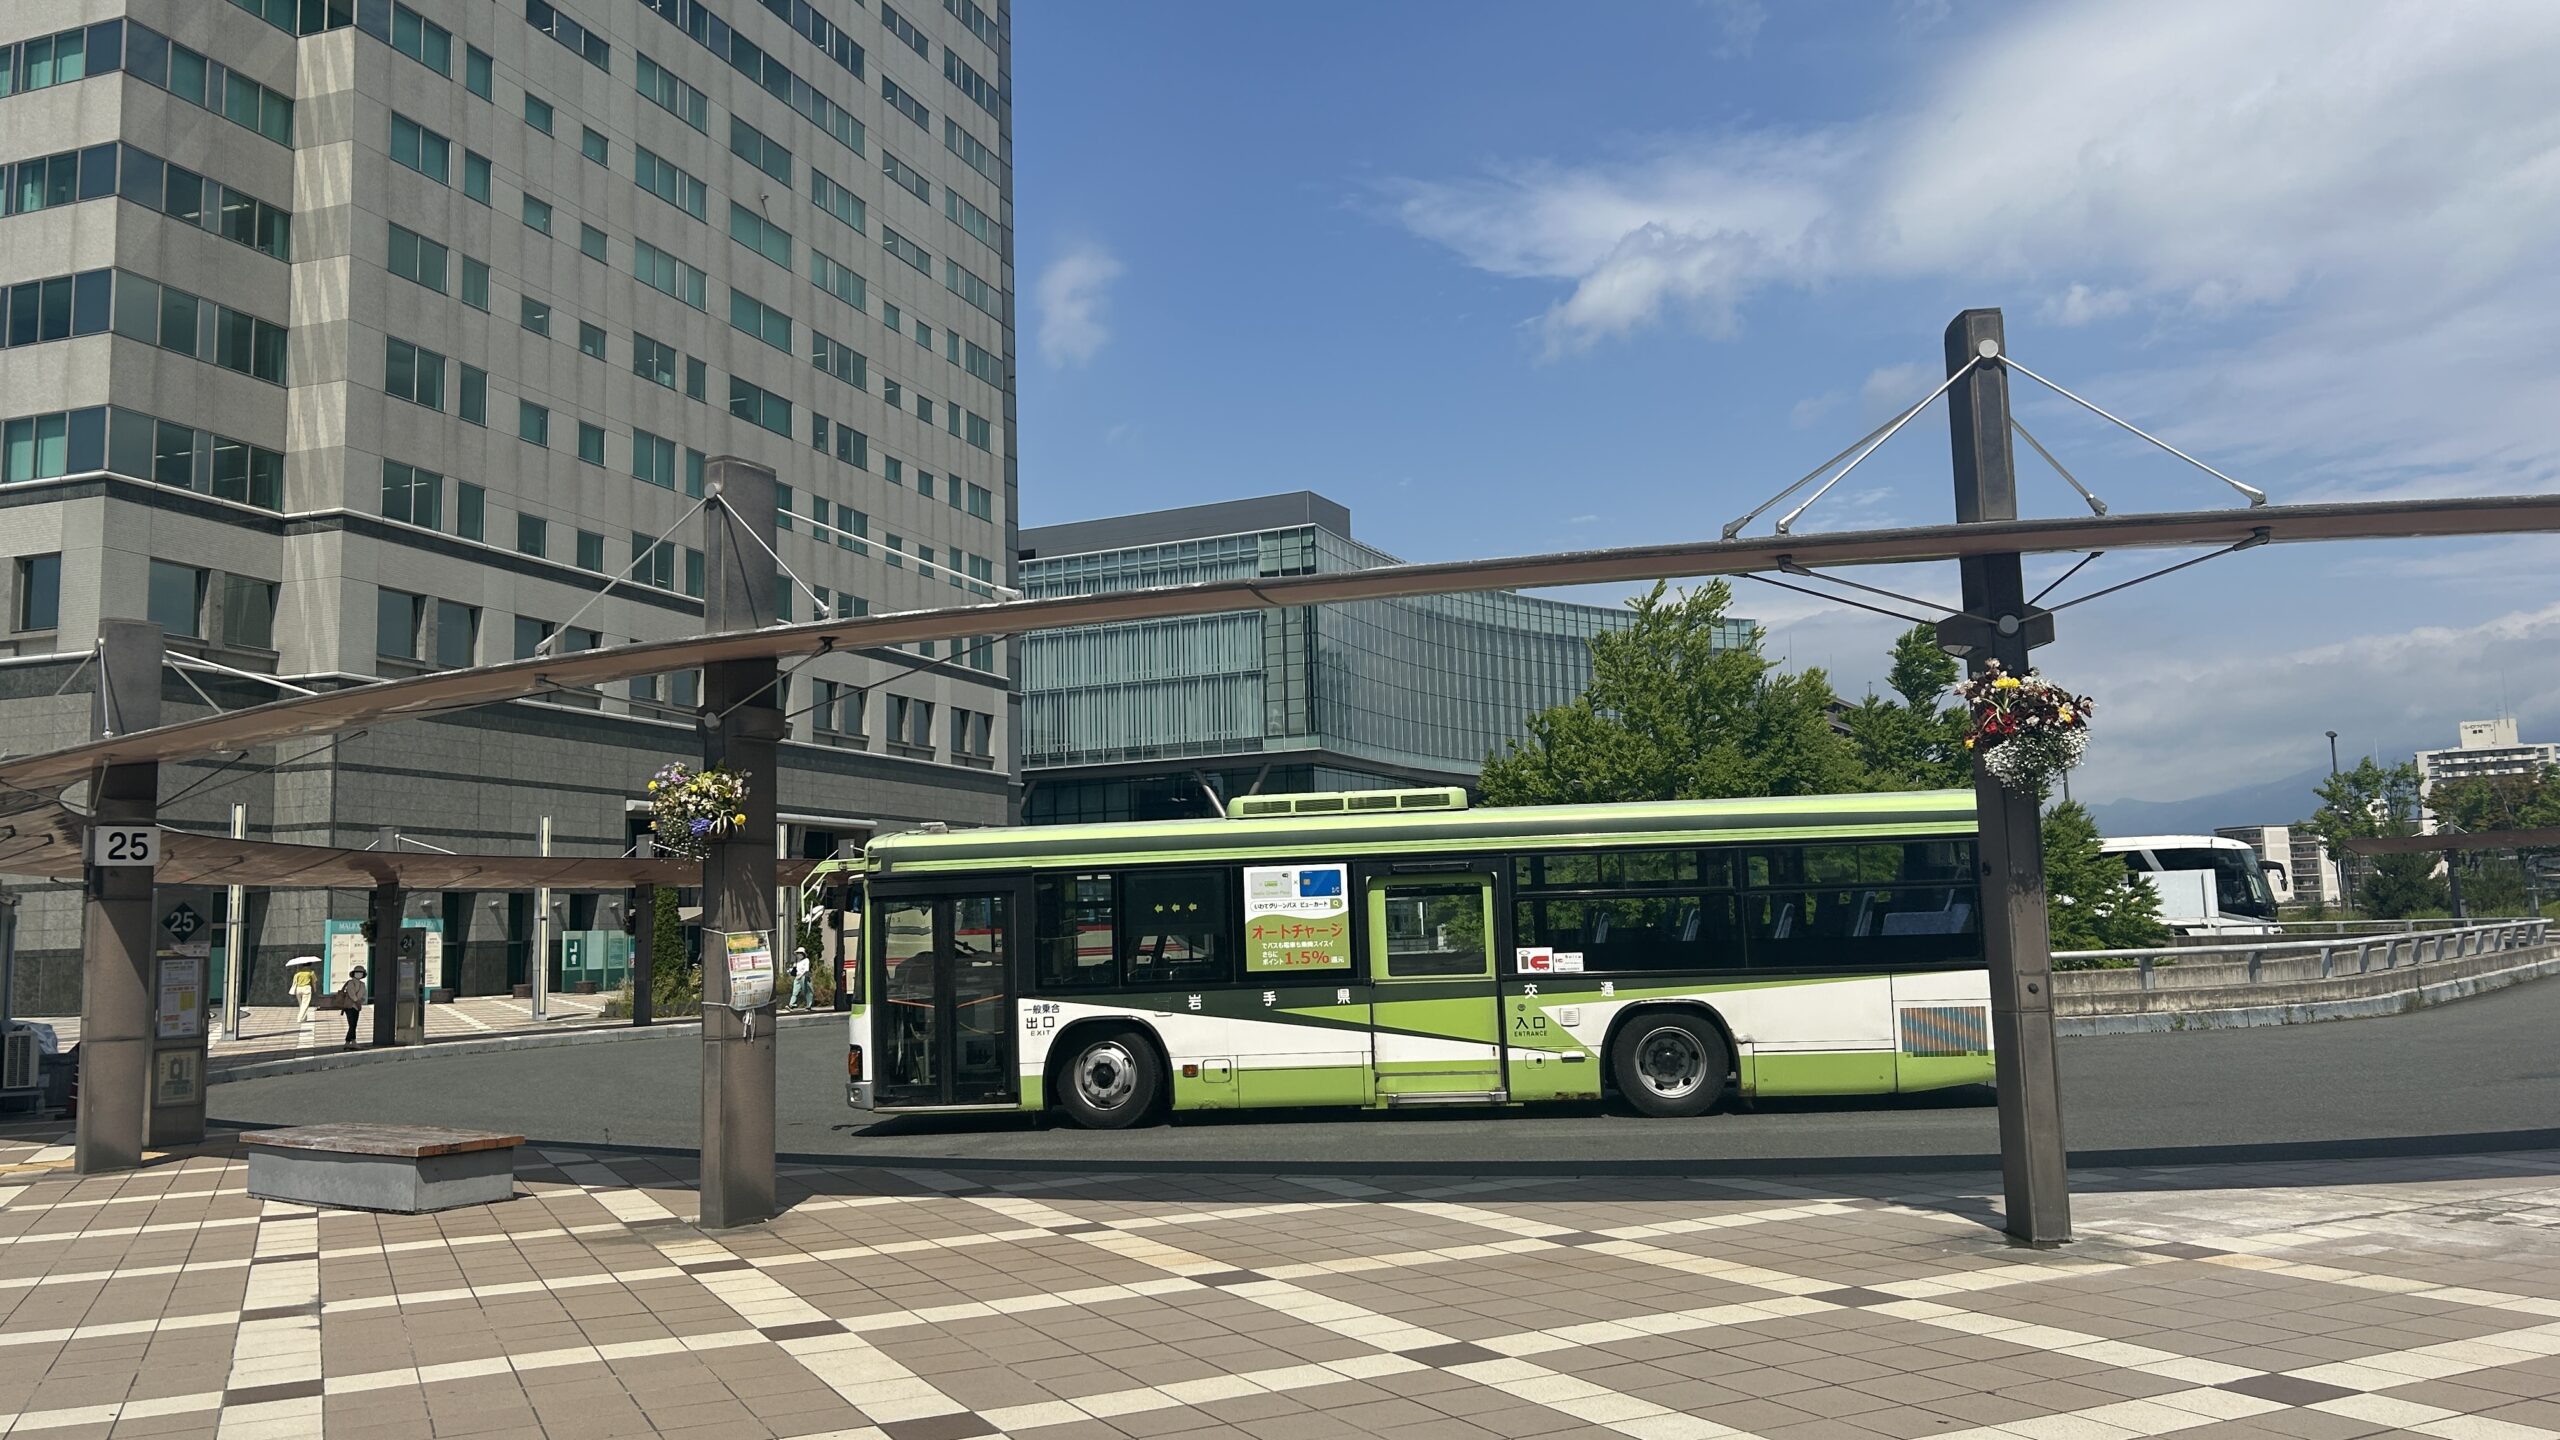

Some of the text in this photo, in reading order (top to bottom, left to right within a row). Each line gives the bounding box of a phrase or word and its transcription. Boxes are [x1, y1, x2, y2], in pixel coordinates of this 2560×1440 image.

[107, 831, 149, 861] 25
[169, 911, 194, 932] 25
[1252, 923, 1343, 940] オートチャージ
[403, 938, 413, 949] 24
[1262, 958, 1284, 966] ポイント
[1285, 951, 1330, 965] 1.5%
[1023, 1003, 1061, 1014] 一般乗合
[1026, 1016, 1055, 1029] 出口
[1515, 1016, 1546, 1029] 入口
[1030, 1029, 1051, 1037] EXIT
